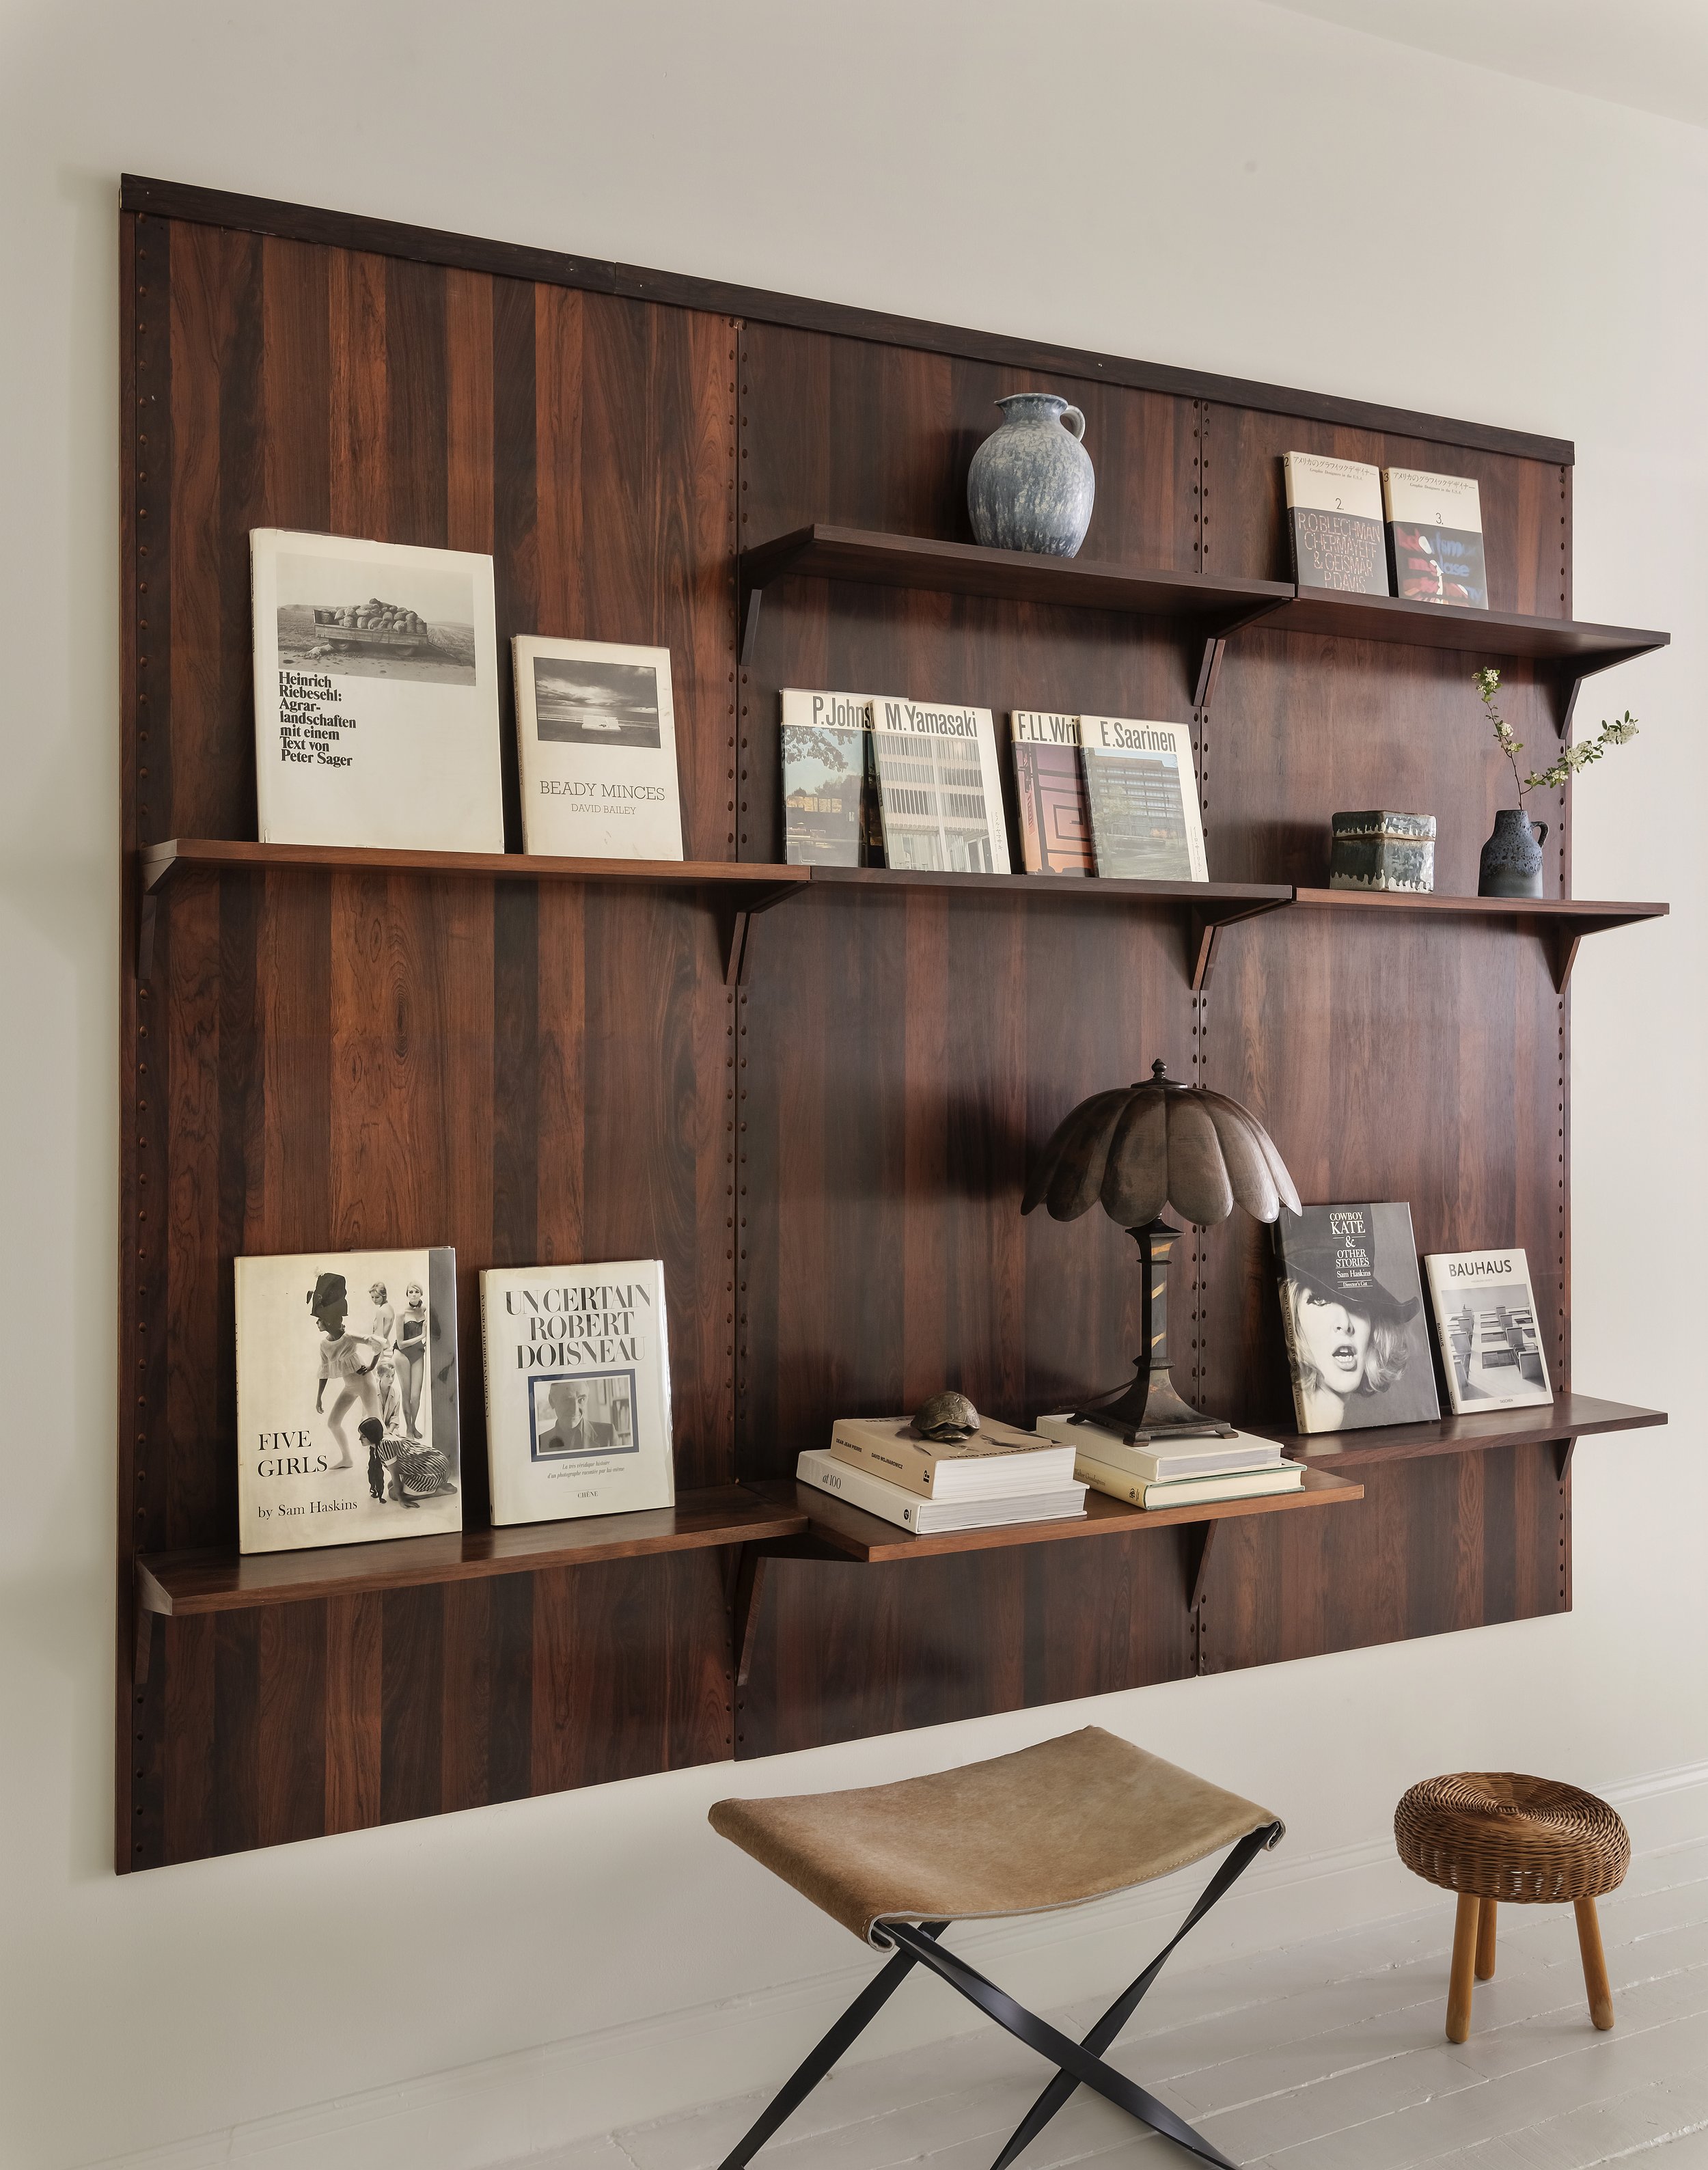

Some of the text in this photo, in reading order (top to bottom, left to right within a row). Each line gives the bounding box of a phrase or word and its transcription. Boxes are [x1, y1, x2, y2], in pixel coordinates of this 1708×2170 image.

[1284, 457, 1289, 467] 2
[1383, 472, 1389, 482] 3
[1335, 497, 1345, 510] 2.
[1435, 512, 1444, 525] 3.
[1314, 551, 1323, 569] &
[279, 671, 332, 689] Heinrich
[279, 685, 342, 702] Riebesehl:
[279, 698, 321, 713] Agrar-
[279, 711, 357, 728] landschaften
[885, 702, 978, 738] M.Yamasaki
[280, 725, 340, 741] mit einem
[1100, 720, 1177, 752] E.Saarinen
[279, 736, 329, 752] Text von
[281, 749, 353, 768] Peter Sager
[540, 780, 665, 801] BEADY MINCES
[571, 803, 637, 815] DAVID BAILEY
[1330, 1211, 1363, 1222] COWBOY
[1330, 1220, 1366, 1235] KATE
[1345, 1235, 1356, 1248] &
[1336, 1257, 1370, 1267] STORIES
[1337, 1249, 1366, 1259] OTHER
[1337, 1269, 1371, 1278] Sam Haskins
[1448, 1259, 1513, 1277] BAUHAUS
[503, 1284, 652, 1315] UN CERTAIN
[528, 1311, 636, 1341] ROBERT
[1436, 1323, 1445, 1347] BAUHAUS
[515, 1336, 648, 1370] DOISNEAU
[258, 1430, 312, 1451] FIVE
[852, 1444, 862, 1453] PIERRE
[258, 1455, 329, 1478] GIRLS
[822, 1473, 842, 1489] at 100
[258, 1499, 357, 1520] by Sam Haskins
